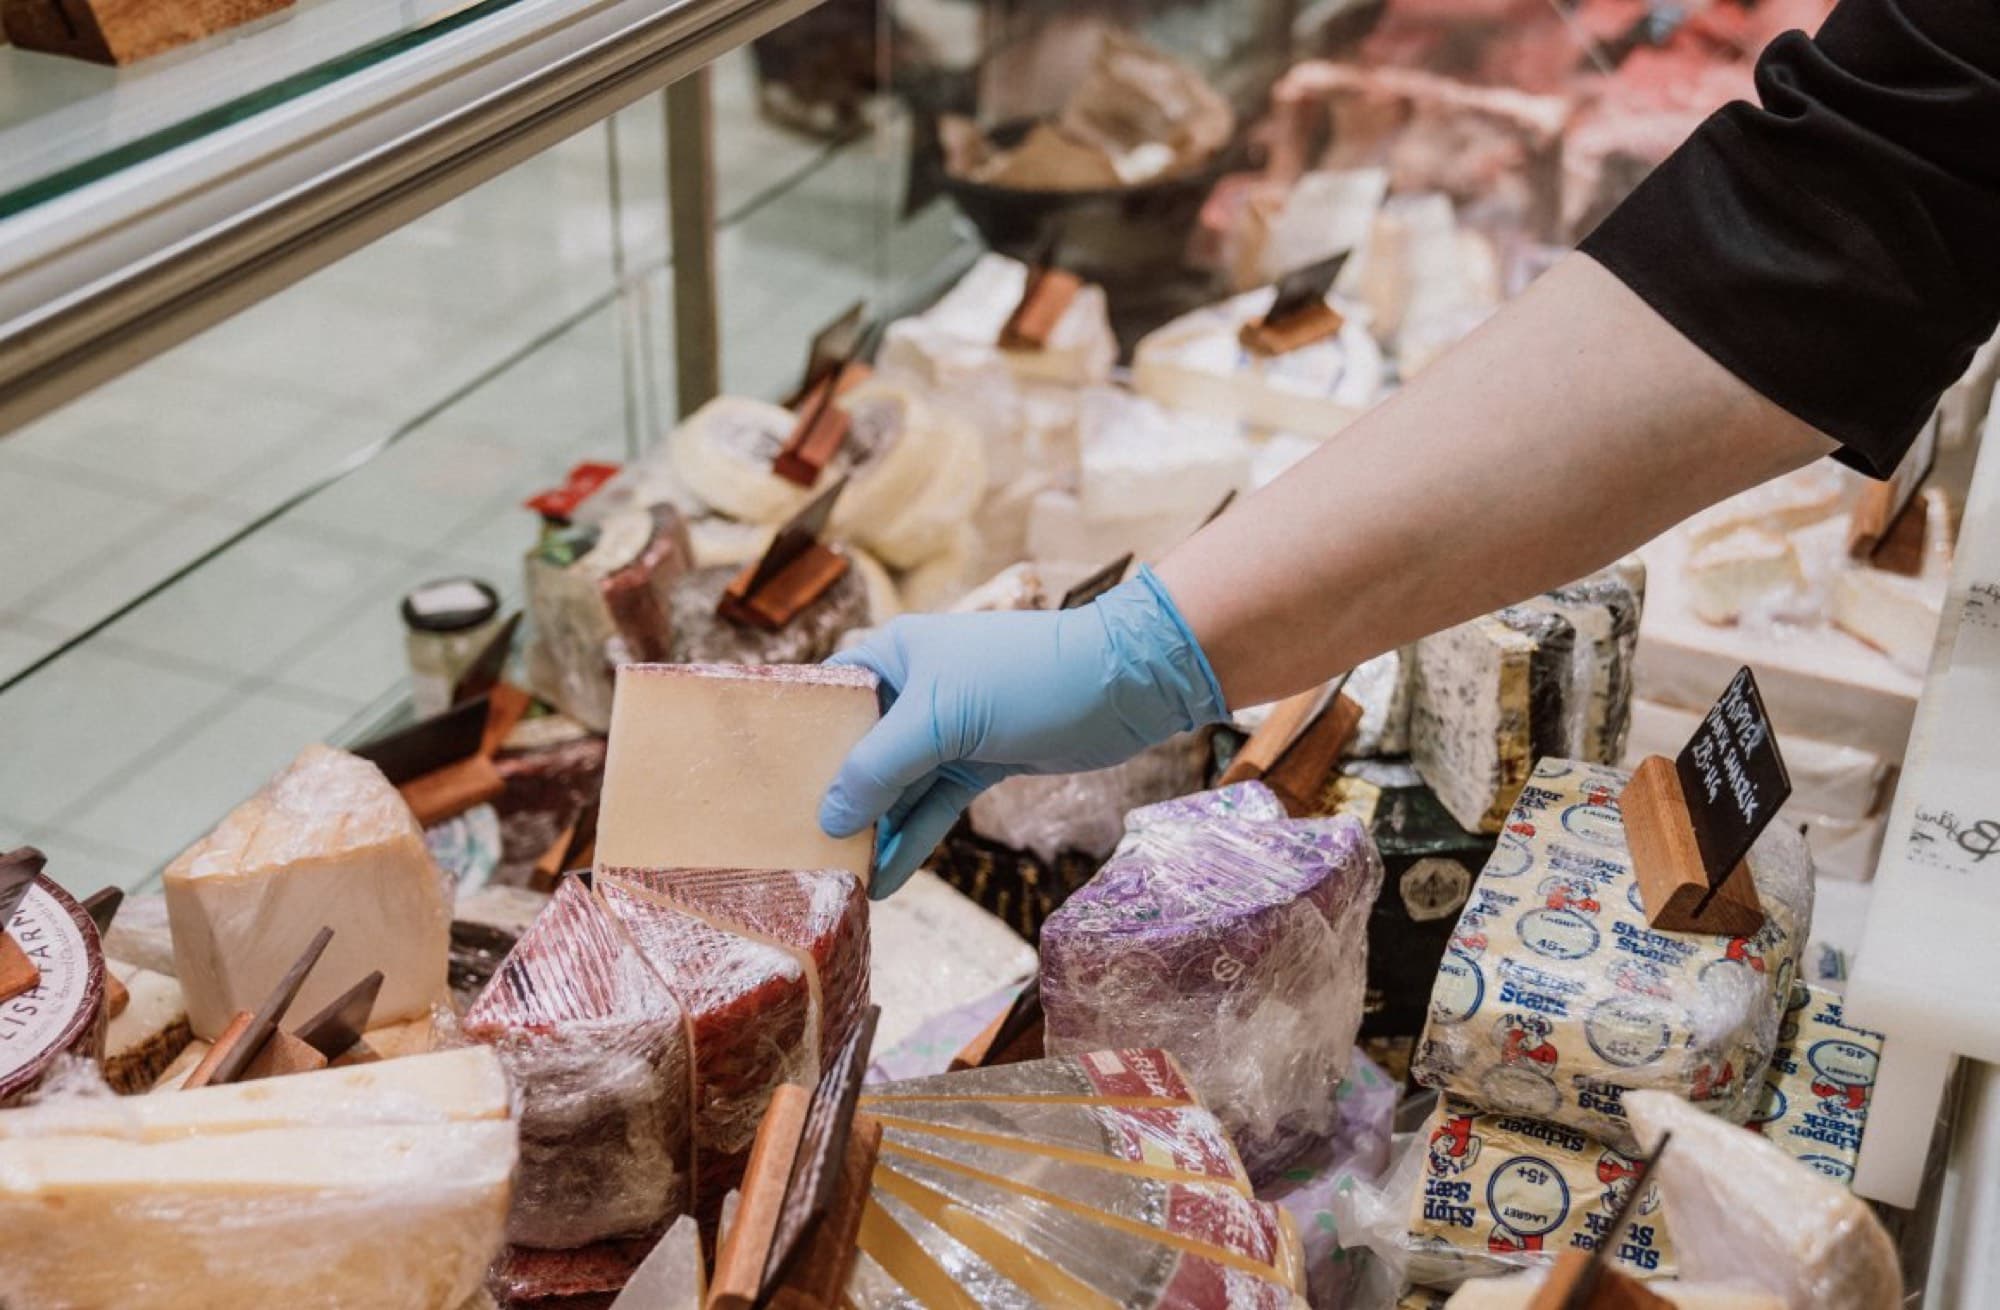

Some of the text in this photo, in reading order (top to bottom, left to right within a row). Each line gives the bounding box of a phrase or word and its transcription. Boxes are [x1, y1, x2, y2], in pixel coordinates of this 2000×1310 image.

[1497, 1117, 1586, 1151] Skipper
[1788, 1125, 1863, 1154] kipper
[1516, 1166, 1549, 1185] 45+
[1503, 1206, 1548, 1224] LAGRET
